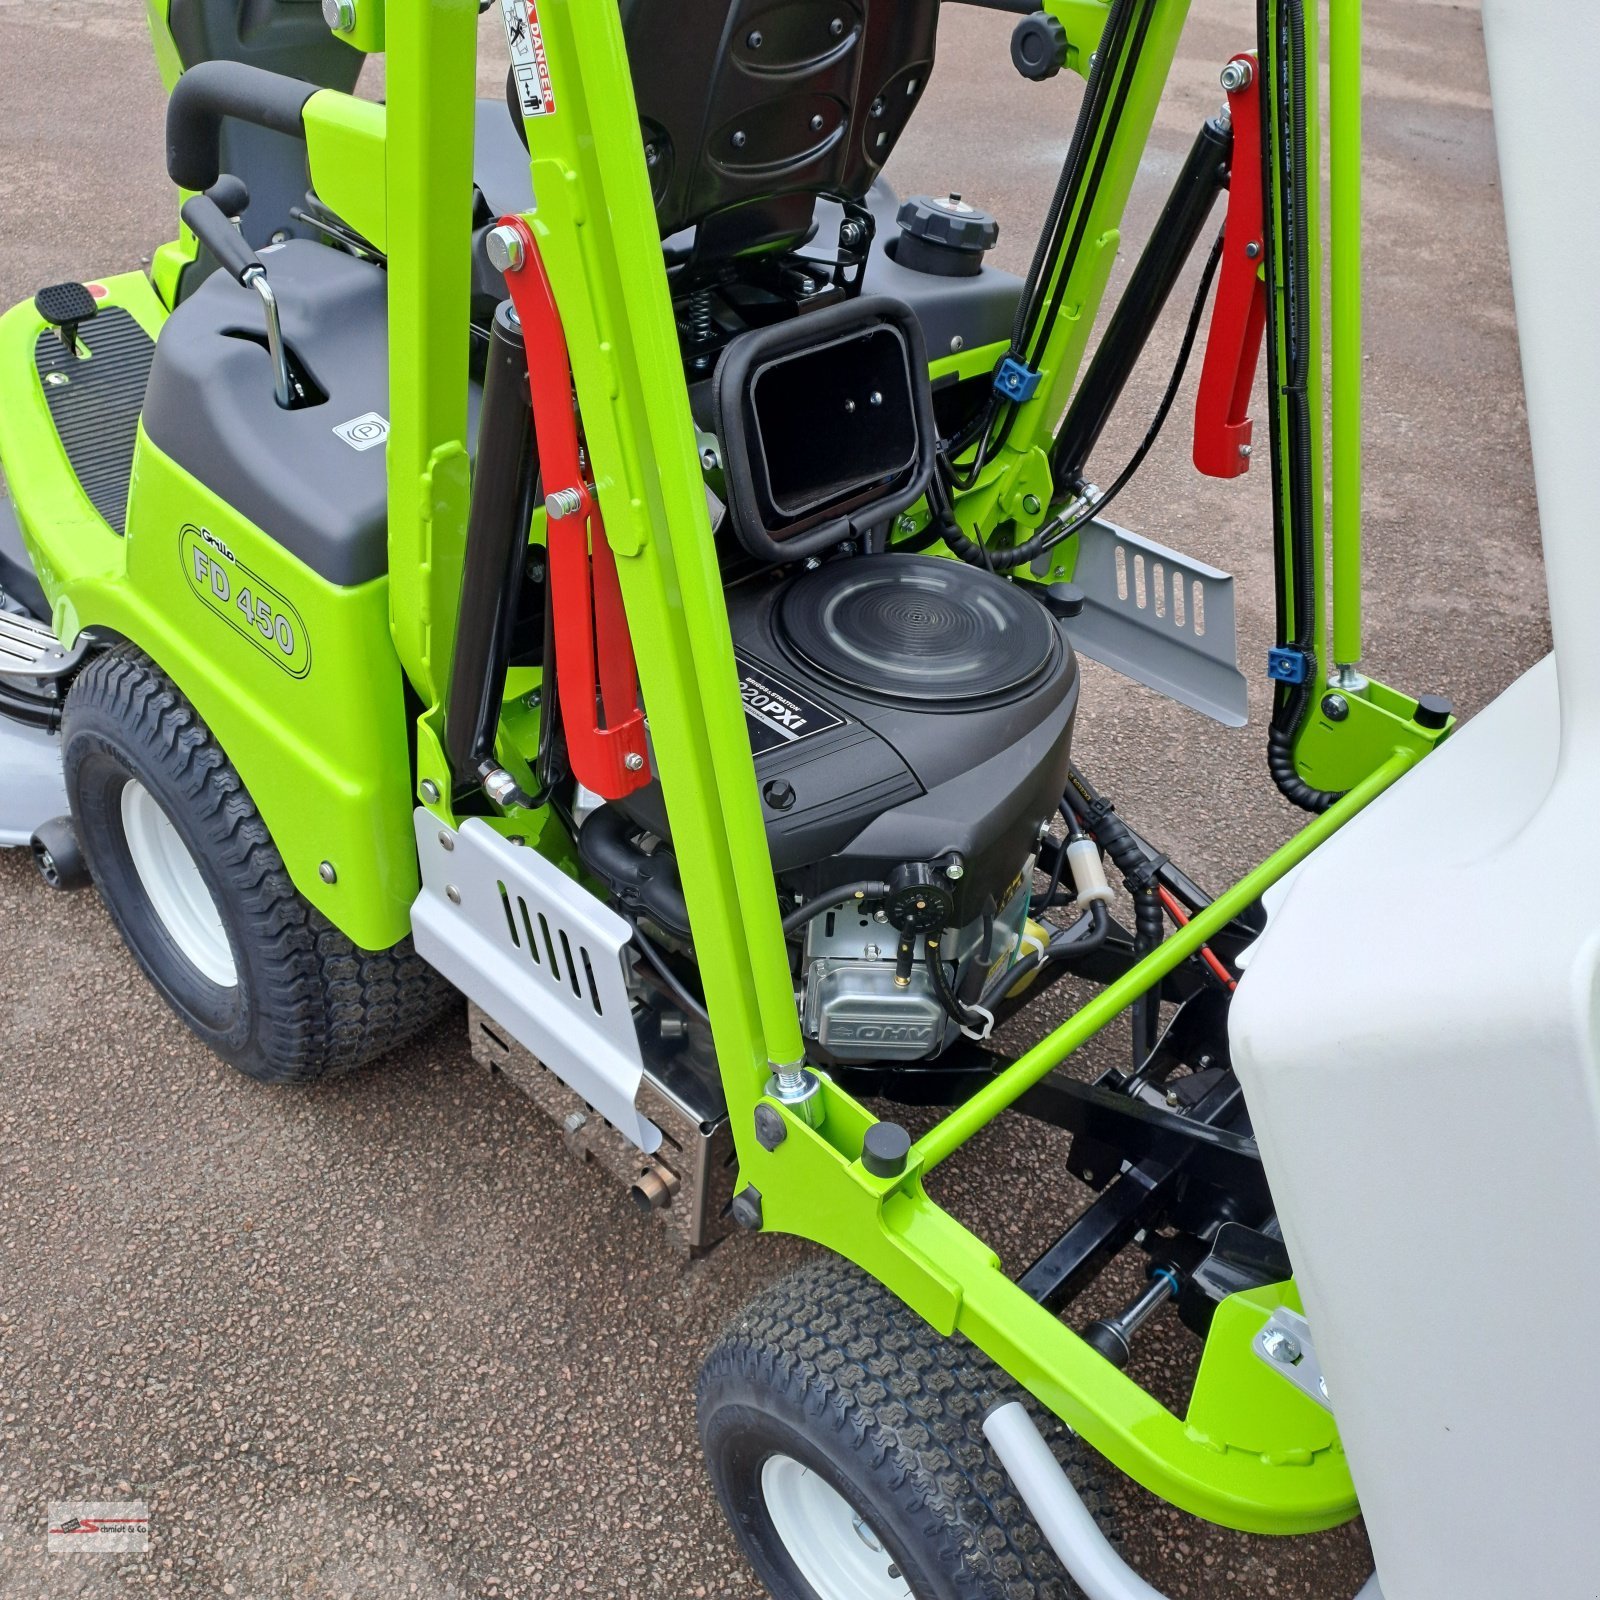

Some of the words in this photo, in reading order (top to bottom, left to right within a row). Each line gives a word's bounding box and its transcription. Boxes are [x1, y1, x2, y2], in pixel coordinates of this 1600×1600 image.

[530, 23, 553, 102] DANGER
[202, 528, 235, 562] Grillo
[193, 544, 230, 602] FD
[236, 586, 294, 656] 450
[856, 1025, 933, 1042] OHV
